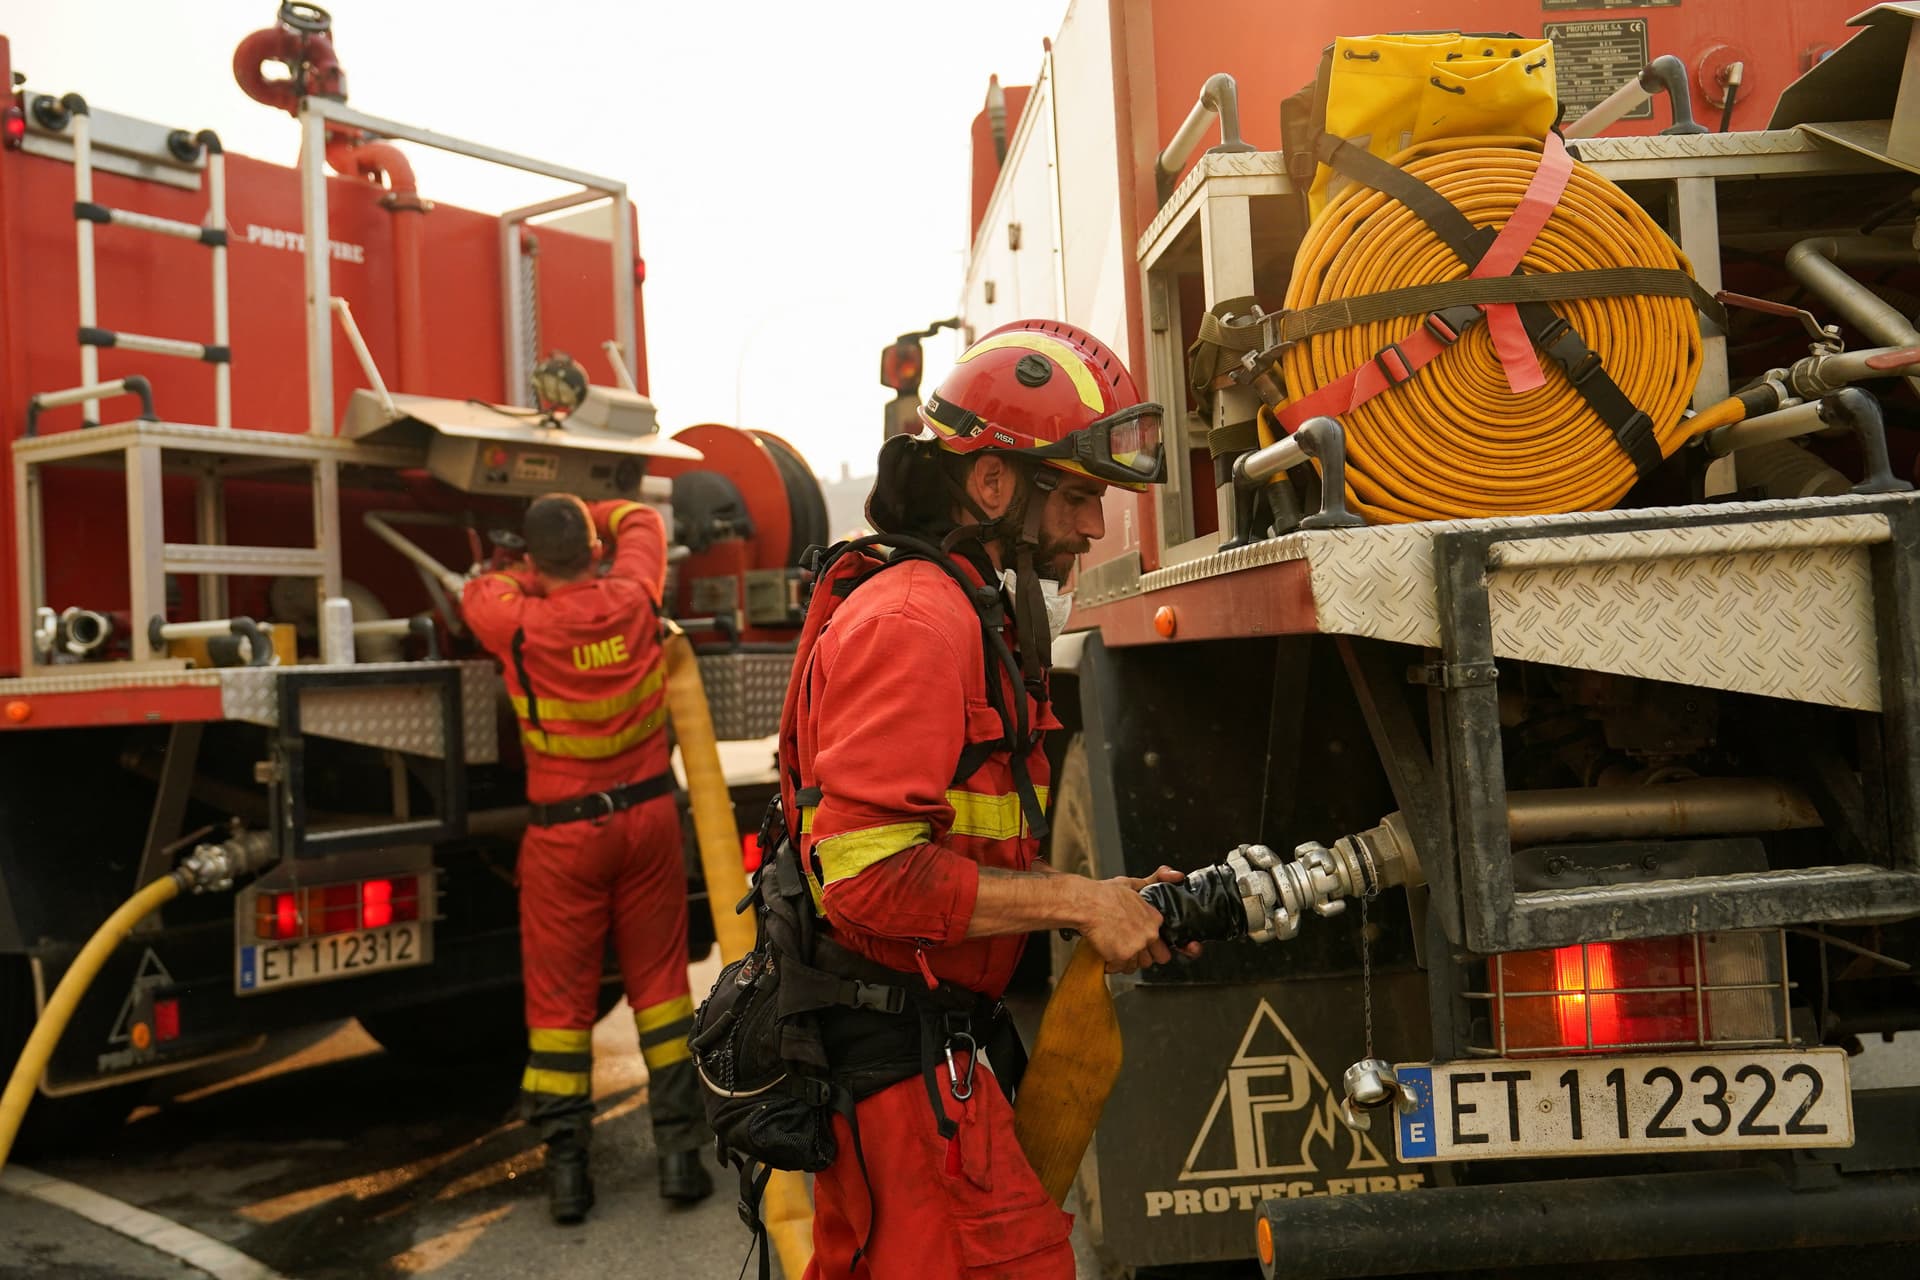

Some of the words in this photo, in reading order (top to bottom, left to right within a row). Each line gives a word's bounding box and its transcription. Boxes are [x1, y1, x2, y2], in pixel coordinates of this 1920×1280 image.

[1630, 22, 1642, 33] CE
[994, 432, 1015, 445] MSA
[573, 635, 629, 670] UME
[262, 943, 299, 981] ET
[311, 927, 413, 974] 112312
[1449, 1070, 1532, 1145] ET
[1558, 1063, 1829, 1140] 112322
[1409, 1122, 1427, 1144] E
